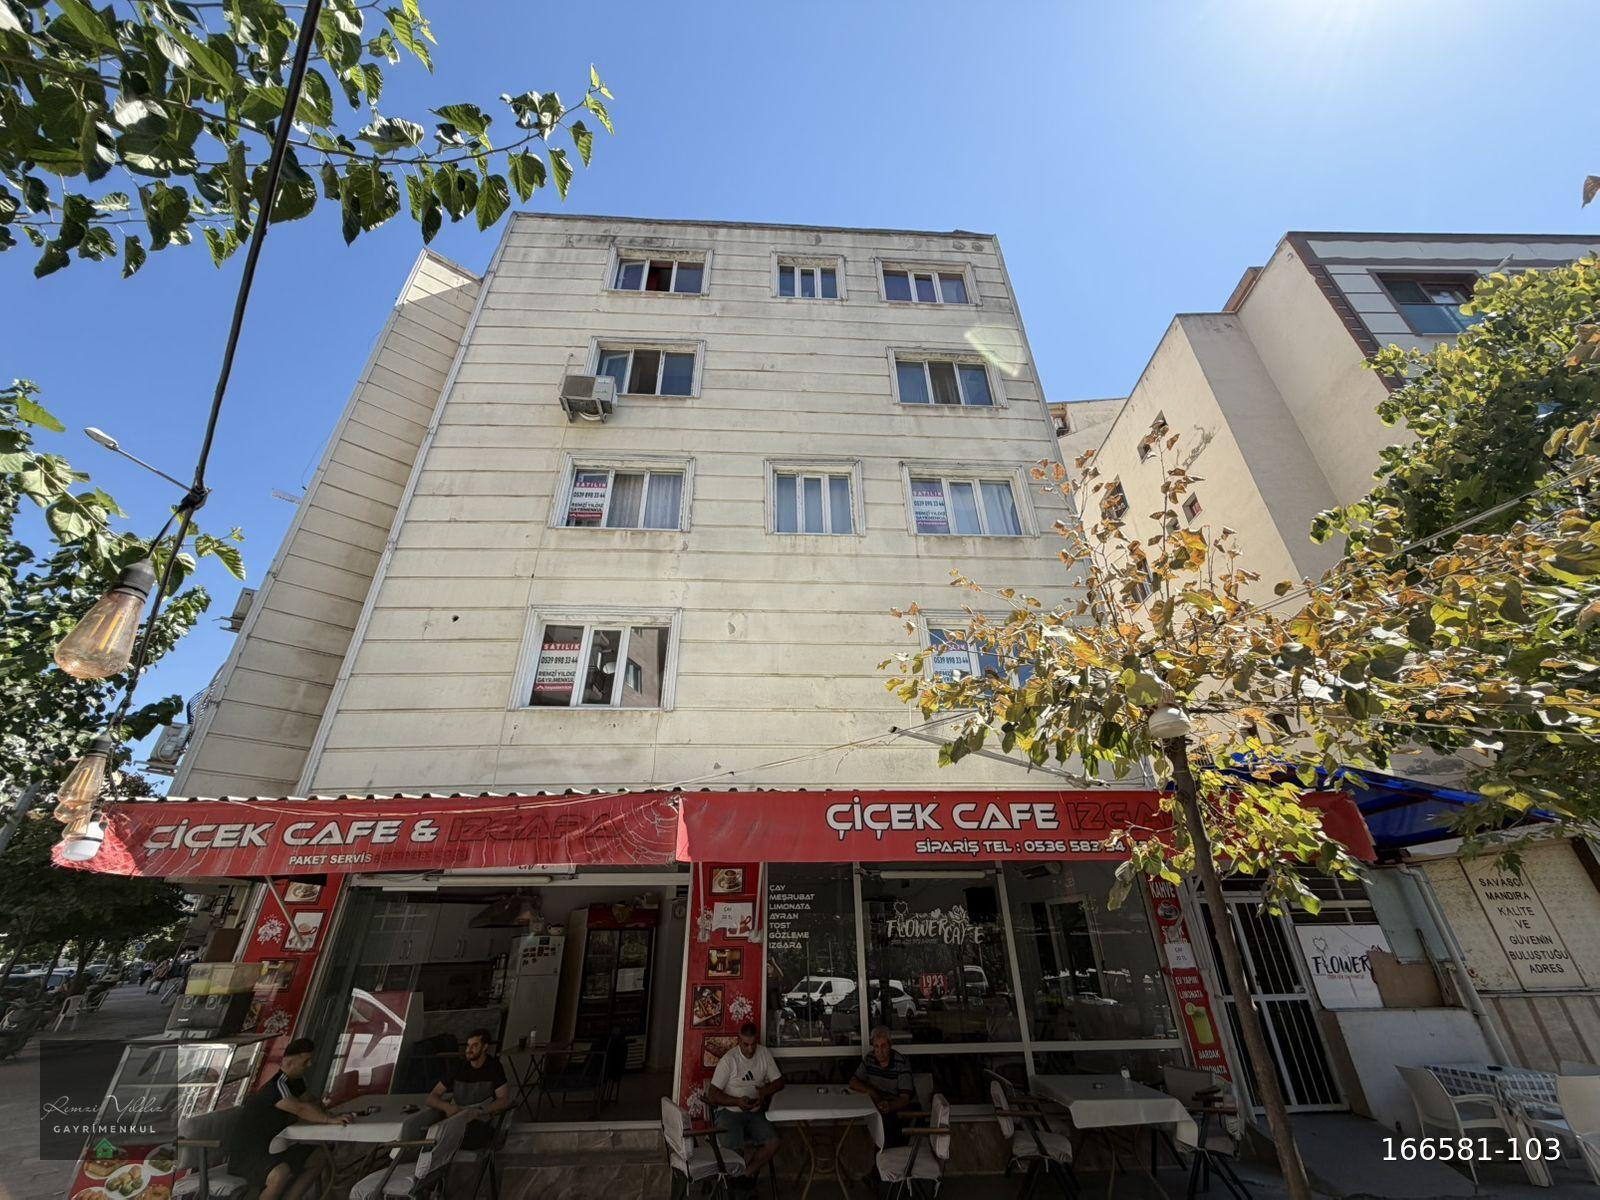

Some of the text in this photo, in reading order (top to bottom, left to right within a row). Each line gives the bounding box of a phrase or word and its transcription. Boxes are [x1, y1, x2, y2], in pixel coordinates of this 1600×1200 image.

[826, 796, 944, 841] ÇİÇEK
[952, 803, 1060, 830] CAFE
[143, 818, 274, 858] ÇİÇEK
[281, 819, 402, 846] CAFE
[410, 819, 440, 843] &
[916, 837, 980, 857] SİPARİŞ
[983, 840, 1012, 852] TEL
[1024, 840, 1067, 853] 0536
[288, 854, 328, 865] PAKET
[330, 852, 372, 864] SERVİS
[1149, 882, 1176, 898] KAHVE
[1485, 892, 1531, 900] MANDIRA
[769, 893, 815, 901] MEŞRUBAT
[886, 917, 948, 938] FLOWER
[1515, 920, 1531, 928] VE
[769, 930, 809, 938] GÖZLEME
[1509, 934, 1553, 944] GÜVENİN
[1311, 955, 1372, 974] FLOWER
[1529, 964, 1564, 974] ADRES
